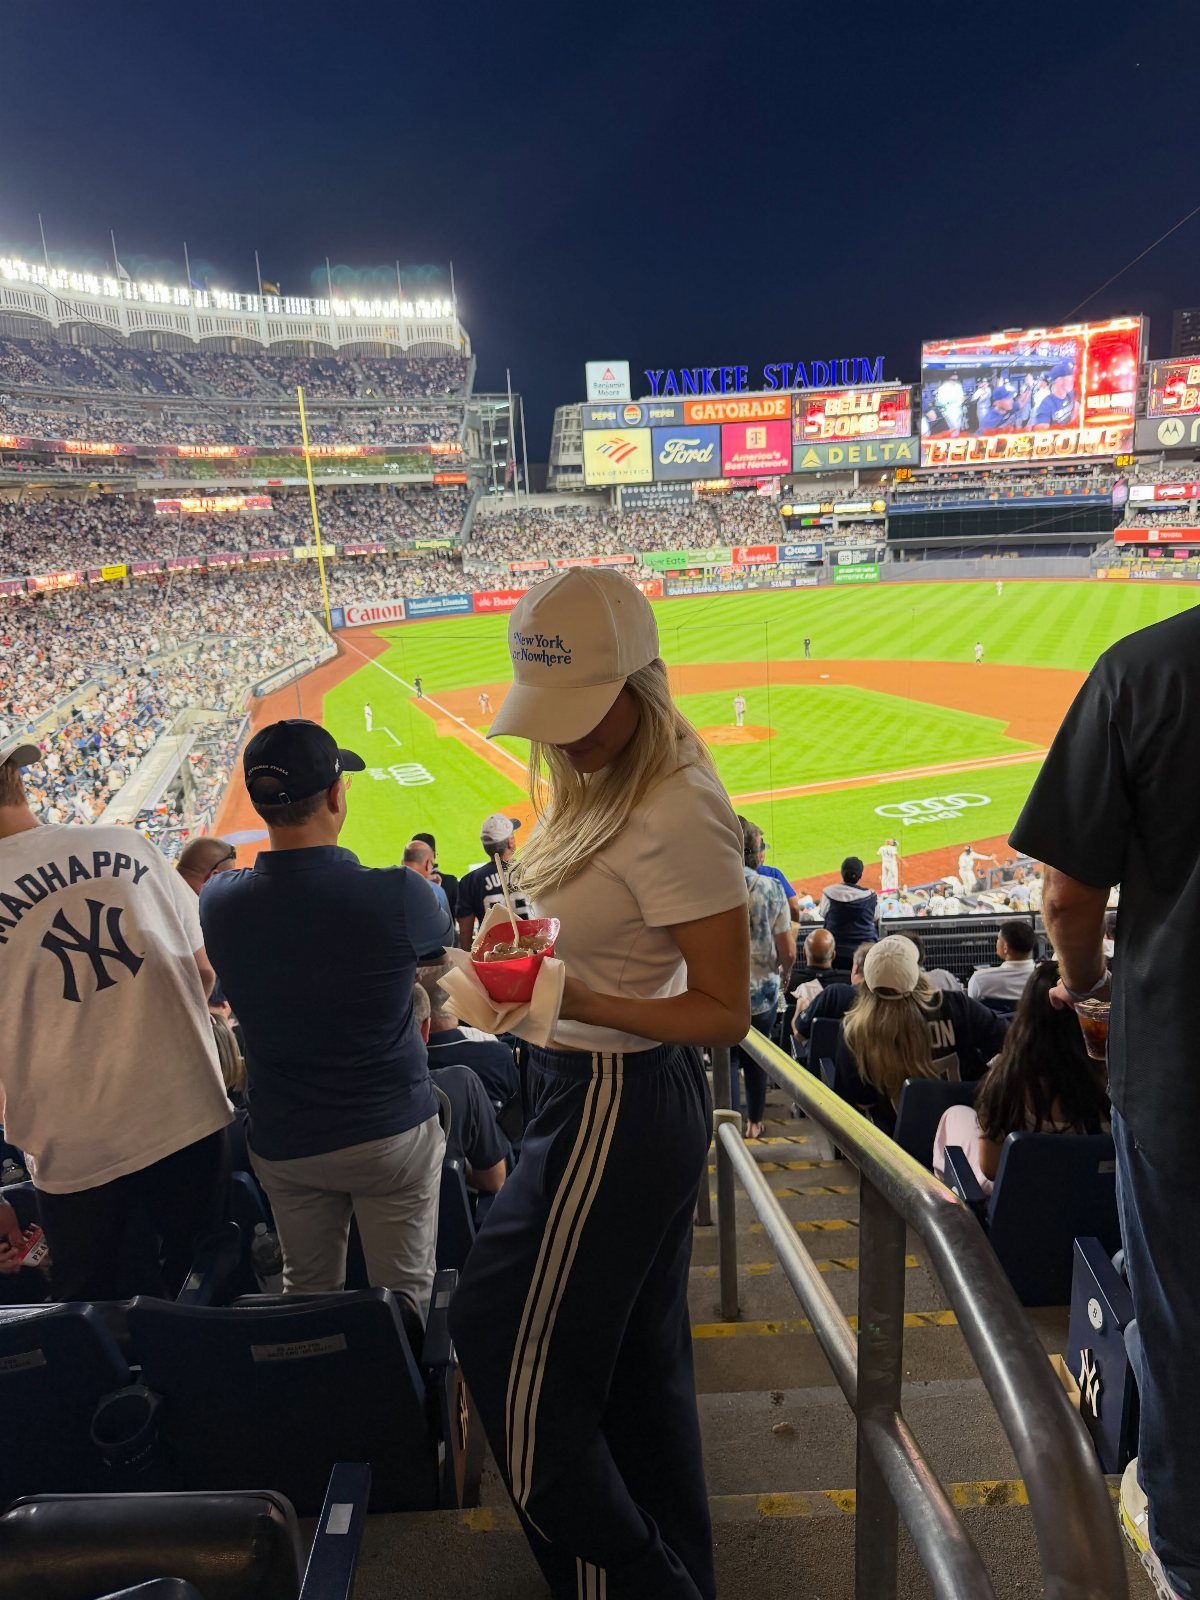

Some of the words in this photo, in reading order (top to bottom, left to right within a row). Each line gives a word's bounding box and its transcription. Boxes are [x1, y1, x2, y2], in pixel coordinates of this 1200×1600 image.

[645, 366, 748, 397] YANKEE
[764, 356, 885, 390] STADIUM
[691, 400, 786, 420] GATORADE
[825, 393, 881, 416] BELLI
[820, 413, 878, 438] BOMB
[659, 438, 715, 464] Ford
[733, 452, 781, 462] America's
[828, 443, 912, 465] DELTA
[725, 461, 746, 471] Best
[747, 459, 789, 469] Network
[666, 557, 686, 566] Eats
[346, 604, 403, 624] Canon
[513, 632, 534, 646] New
[534, 634, 572, 654] York
[512, 650, 521, 660] or
[521, 647, 572, 667] Nowhere
[902, 809, 965, 826] Audi
[41, 898, 145, 1002] NY
